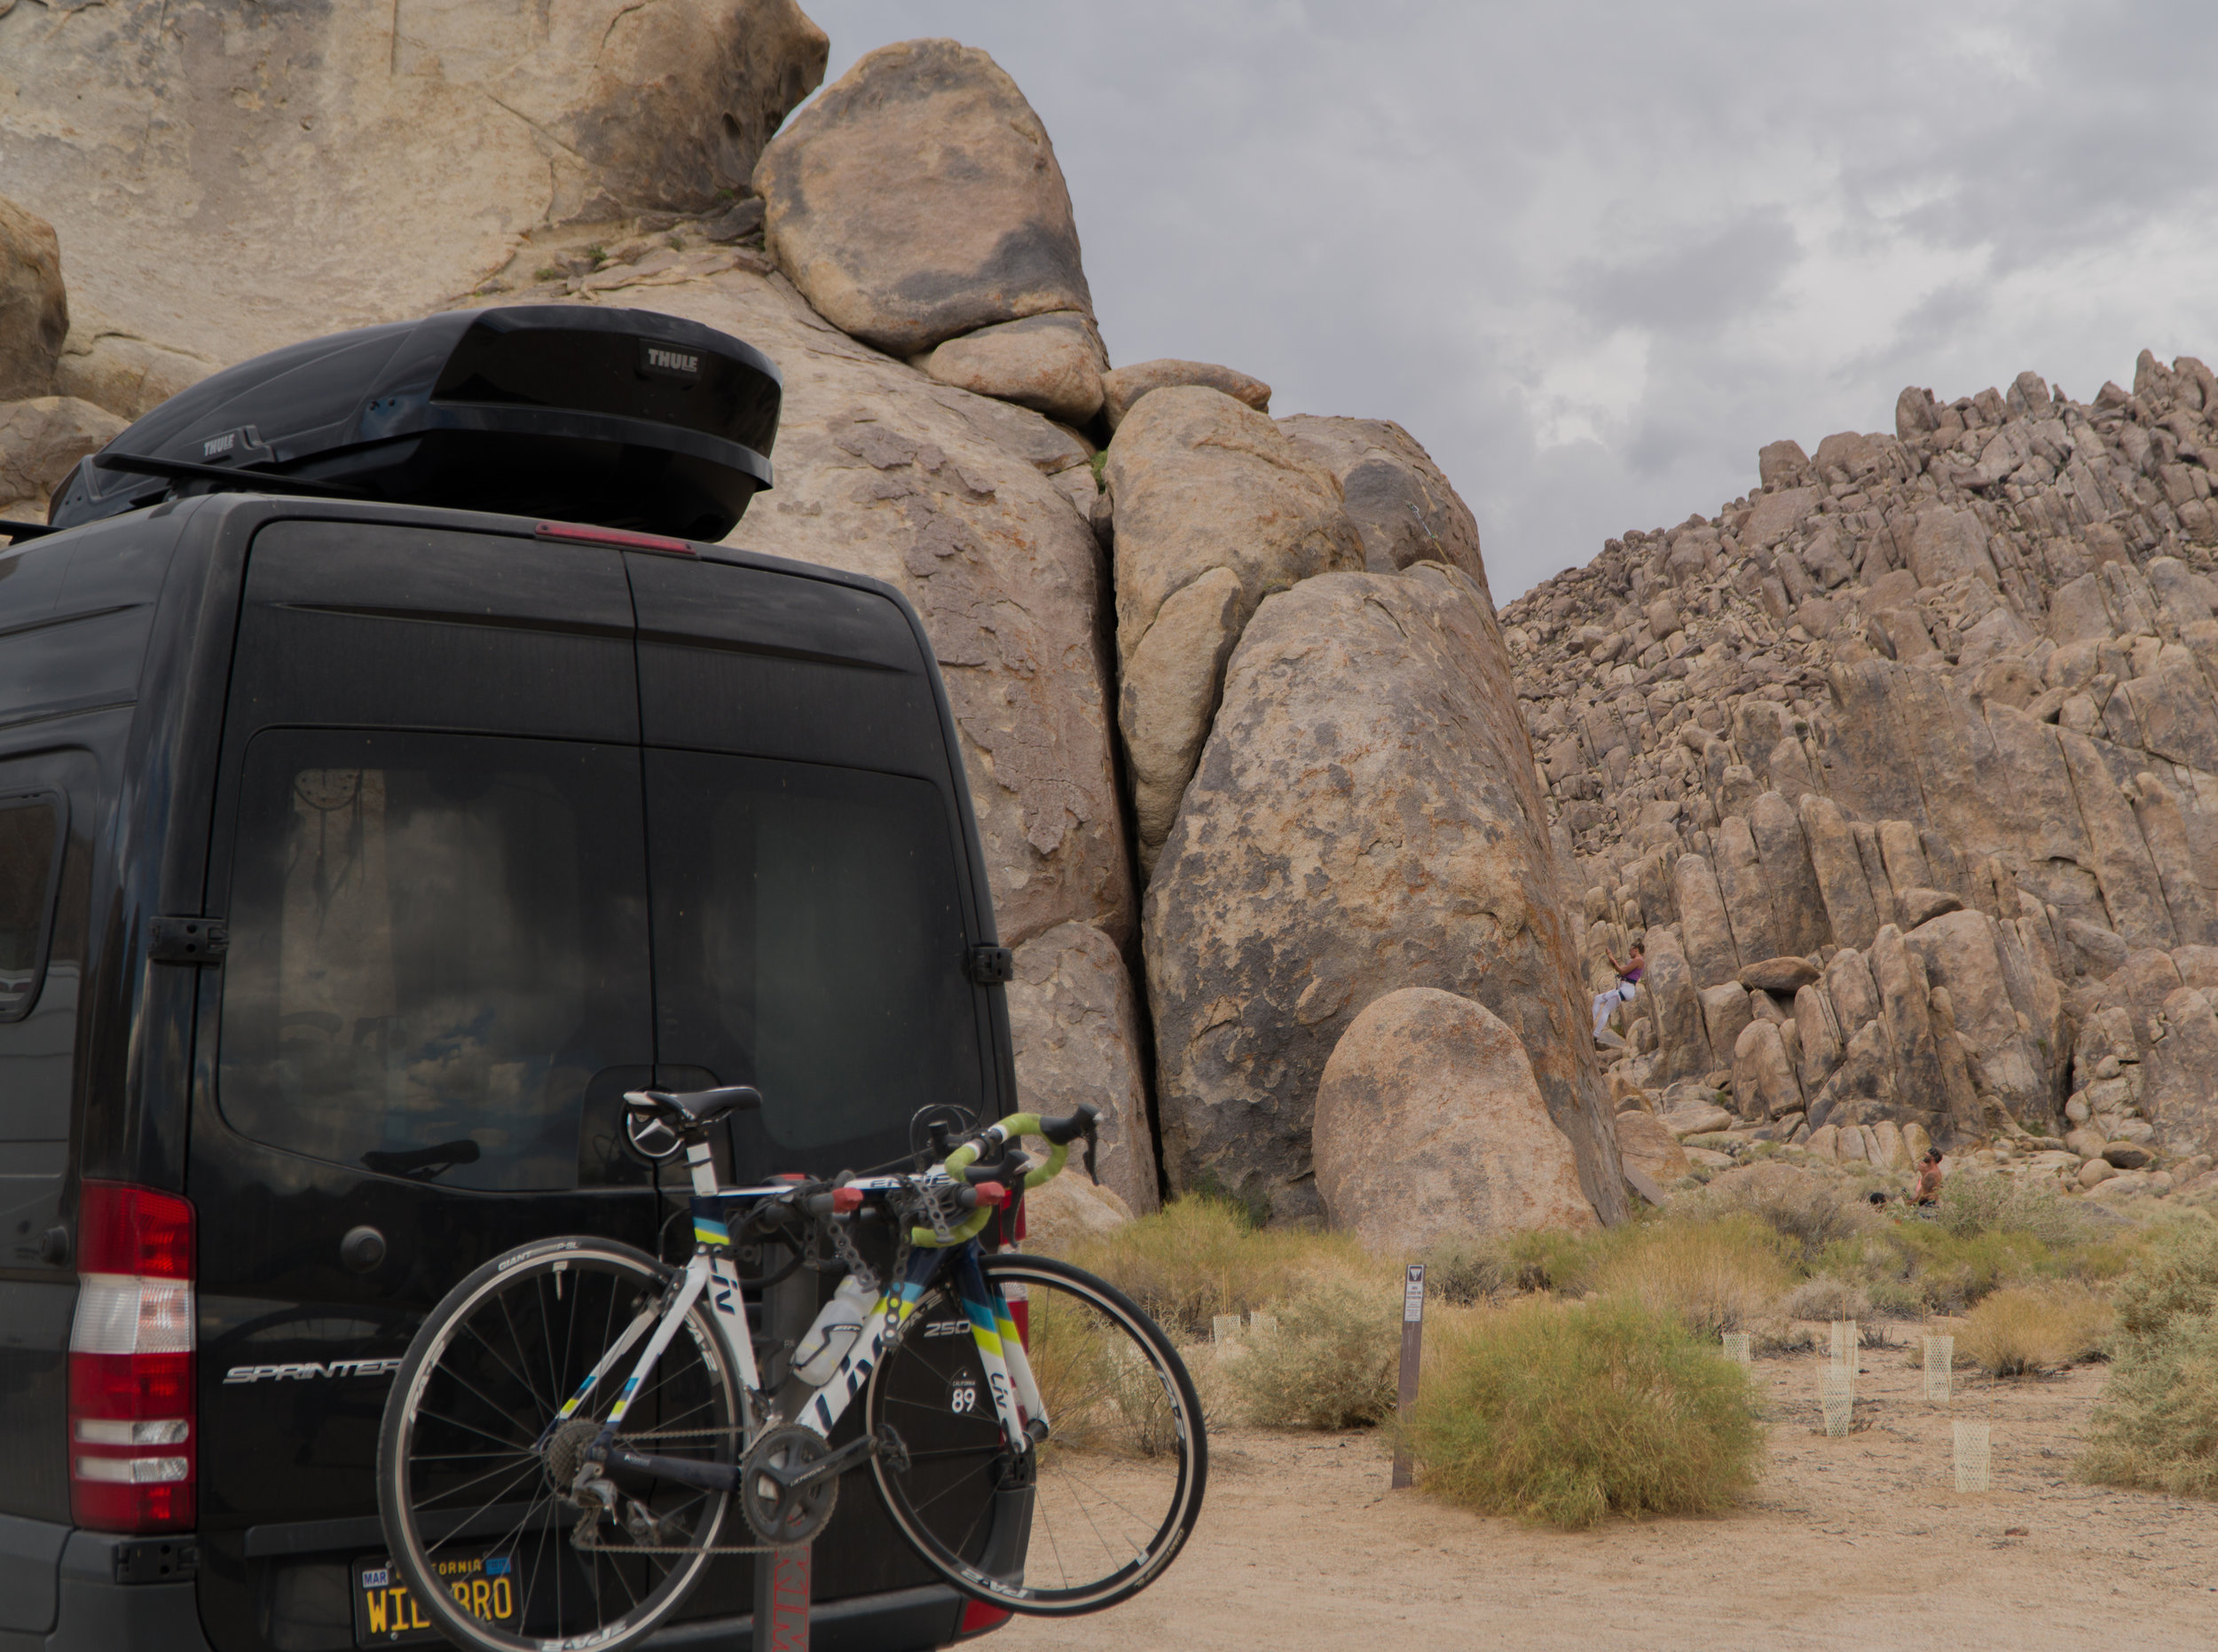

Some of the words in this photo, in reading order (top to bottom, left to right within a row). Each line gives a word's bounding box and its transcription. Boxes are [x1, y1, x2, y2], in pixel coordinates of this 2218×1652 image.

[648, 348, 698, 373] THULE
[204, 433, 235, 456] THULE
[497, 1250, 532, 1271] GIANT
[923, 1318, 971, 1338] 250
[223, 1357, 404, 1384] SPRINTER
[952, 1388, 976, 1413] 89
[364, 1570, 386, 1585] MAR
[366, 1577, 513, 1633] WILBRO
